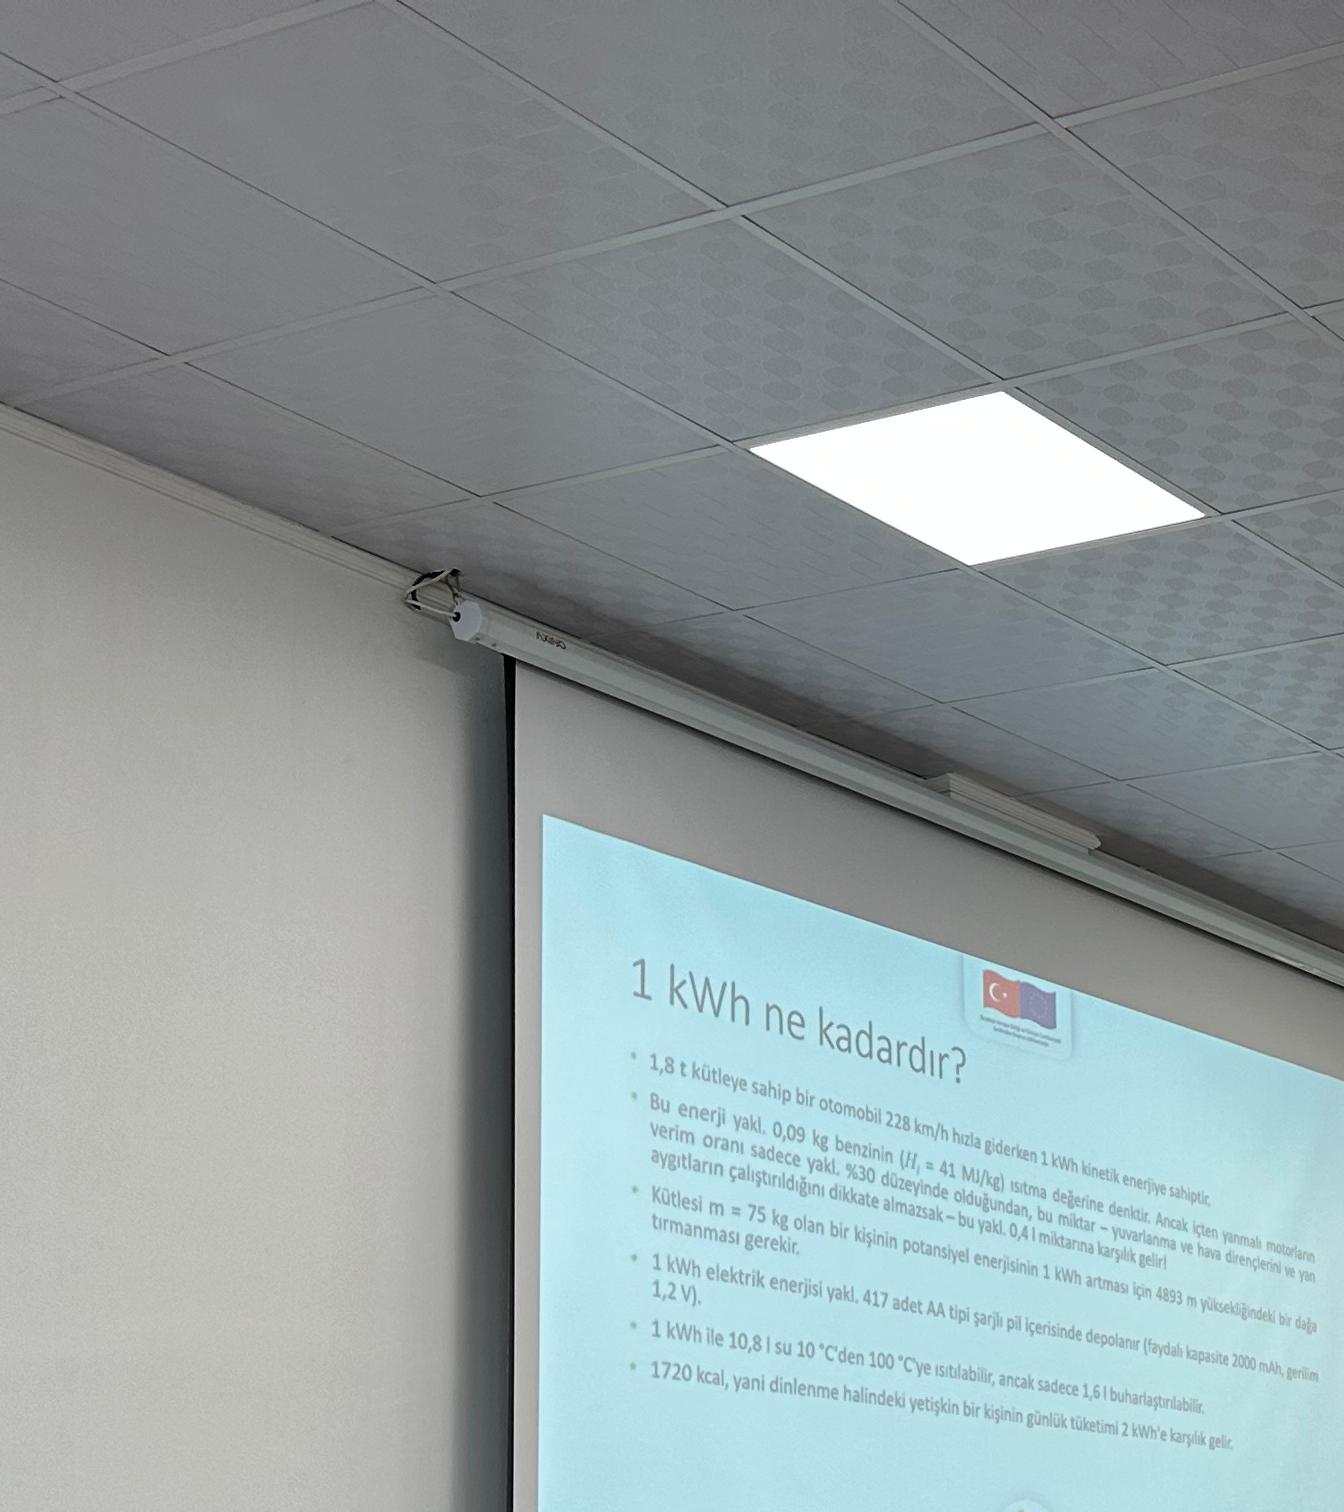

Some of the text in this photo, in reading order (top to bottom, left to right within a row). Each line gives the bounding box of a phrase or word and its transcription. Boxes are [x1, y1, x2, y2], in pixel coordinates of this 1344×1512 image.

[631, 957, 653, 1001] 1
[668, 962, 750, 1027] kWh
[765, 1001, 806, 1041] ne
[818, 1005, 967, 1084] kadardır?
[649, 1052, 675, 1076] 1,8
[691, 1060, 748, 1093] kütleye
[751, 1079, 792, 1106] sahip
[795, 1086, 816, 1108] bir
[818, 1097, 882, 1125] otomobil
[885, 1110, 911, 1132] 228
[913, 1116, 949, 1143] km/h
[951, 1126, 982, 1150] hızla
[983, 1136, 1038, 1164] giderken
[1040, 1150, 1049, 1167] 1
[1050, 1151, 1079, 1174] kWh
[1080, 1159, 1121, 1185] kinetik
[1121, 1173, 1167, 1197] enerjiye
[649, 1091, 671, 1114] Bu
[677, 1102, 726, 1129] enerji
[732, 1113, 766, 1135] yakl.
[771, 1120, 806, 1144] 0,09
[812, 1128, 829, 1153] kg
[834, 1133, 894, 1164] benzinin
[938, 1159, 956, 1179] 41
[961, 1163, 1005, 1193] MJ/kg)
[1009, 1179, 1047, 1200] ısıtma
[1051, 1186, 1105, 1213] değerine
[1154, 1210, 1189, 1233] Ancak
[649, 1121, 695, 1146] verim
[701, 1133, 745, 1155] oranı
[750, 1143, 801, 1168] sadece
[805, 1155, 840, 1177] yakl.
[844, 1162, 876, 1185] %30
[880, 1170, 949, 1201] düzeyinde
[952, 1187, 1033, 1222] olduğundan,
[1036, 1204, 1053, 1224] bu
[1057, 1212, 1096, 1233] miktar
[1110, 1223, 1177, 1251] yuvarlanma
[1179, 1241, 1194, 1255] ve
[1196, 1241, 1222, 1261] hava
[1283, 1264, 1296, 1279] ve
[1297, 1268, 1316, 1284] yan
[650, 1148, 724, 1177] aygıtların
[727, 1162, 825, 1198] çalıştırıldığını
[828, 1182, 880, 1209] dikkate
[882, 1194, 944, 1224] almazsak
[957, 1209, 975, 1230] bu
[976, 1217, 1006, 1237] yakl.
[1008, 1221, 1029, 1242] 0,4
[1038, 1230, 1095, 1255] miktarına
[1096, 1239, 1137, 1264] karşılık
[651, 1212, 800, 1256] tırmanması gerekir.
[651, 1184, 703, 1213] Kütlesi
[708, 1200, 725, 1217] m
[747, 1202, 767, 1224] 75
[771, 1207, 789, 1232] kg
[792, 1214, 825, 1236] olan
[829, 1219, 850, 1240] bir
[853, 1224, 898, 1250] kişinin
[902, 1238, 970, 1265] potansiyel
[973, 1252, 1039, 1278] enerjisinin
[1042, 1263, 1050, 1280] 1
[1054, 1264, 1082, 1286] kWh
[1085, 1274, 1129, 1295] artması
[1155, 1285, 1183, 1306] 4893
[1186, 1295, 1198, 1308] m
[1278, 1311, 1293, 1328] bir
[1294, 1314, 1318, 1335] dağa
[652, 1278, 677, 1302] 1,2
[652, 1252, 662, 1271] 1
[666, 1253, 701, 1279] kWh
[704, 1262, 765, 1289] elektrik
[768, 1275, 823, 1300] enerjisi
[825, 1283, 859, 1305] yakl.
[861, 1288, 889, 1309] 417
[891, 1295, 924, 1315] adet
[925, 1299, 946, 1319] AA
[948, 1304, 970, 1325] tipi
[1006, 1314, 1022, 1333] pil
[1024, 1316, 1083, 1342] içerisinde
[1084, 1327, 1141, 1352] depolanır
[1142, 1336, 1184, 1359] (faydalı
[1185, 1344, 1230, 1367] kapasite
[1231, 1352, 1257, 1372] 2000
[1258, 1359, 1285, 1378] mAh,
[651, 1318, 662, 1339] 1
[665, 1319, 702, 1344] kWh
[705, 1326, 724, 1348] ile
[728, 1330, 763, 1355] 10,8
[774, 1340, 792, 1356] su
[796, 1339, 816, 1360] 10
[868, 1350, 895, 1371] 100
[998, 1373, 1035, 1391] ancak
[1036, 1377, 1079, 1397] sadece
[1081, 1382, 1101, 1402] 1,6
[651, 1359, 693, 1382] 1720
[696, 1363, 729, 1391] kcal,
[732, 1373, 765, 1393] yani
[768, 1375, 839, 1401] dinlenme
[842, 1383, 906, 1409] halindeki
[908, 1395, 960, 1417] yetişkin
[962, 1399, 981, 1418] bir
[983, 1402, 1024, 1425] kişinin
[1025, 1409, 1068, 1430] günlük
[1069, 1415, 1119, 1436] tüketimi
[1120, 1420, 1129, 1437] 2
[1169, 1426, 1207, 1448] karşılık
